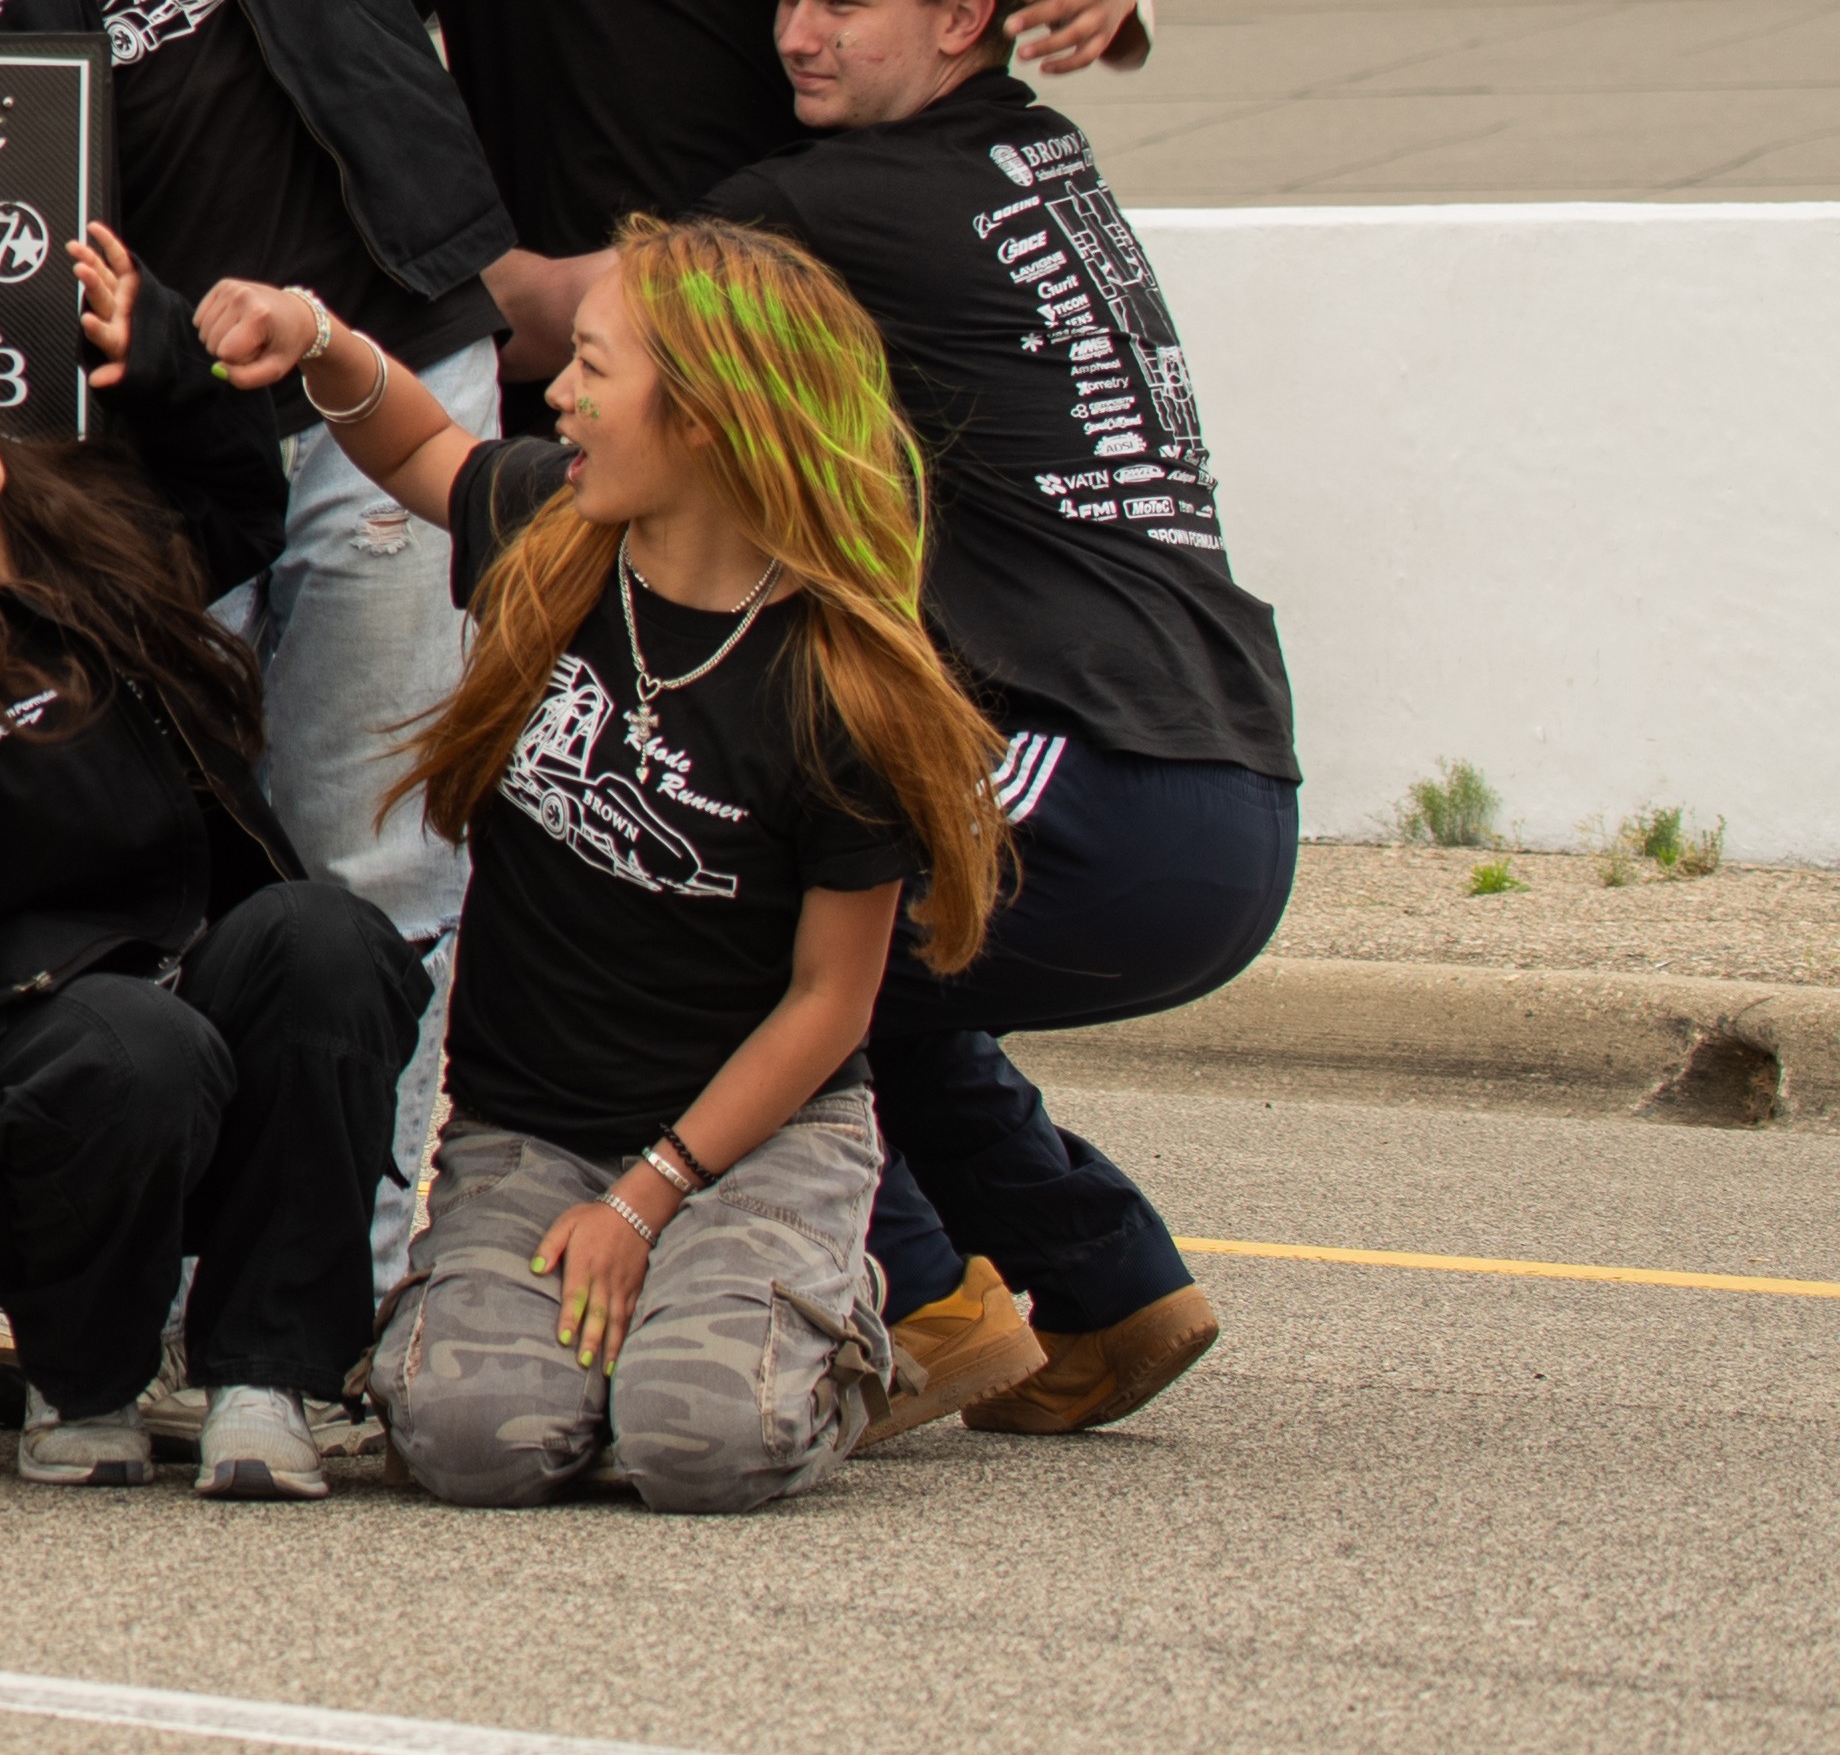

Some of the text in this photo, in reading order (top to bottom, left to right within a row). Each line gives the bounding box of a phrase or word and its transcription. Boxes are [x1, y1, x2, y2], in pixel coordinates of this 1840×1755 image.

[993, 196, 1041, 222] BOEING
[1063, 469, 1110, 490] VATN
[1079, 500, 1117, 520] FMI
[582, 789, 639, 842] BROWN
